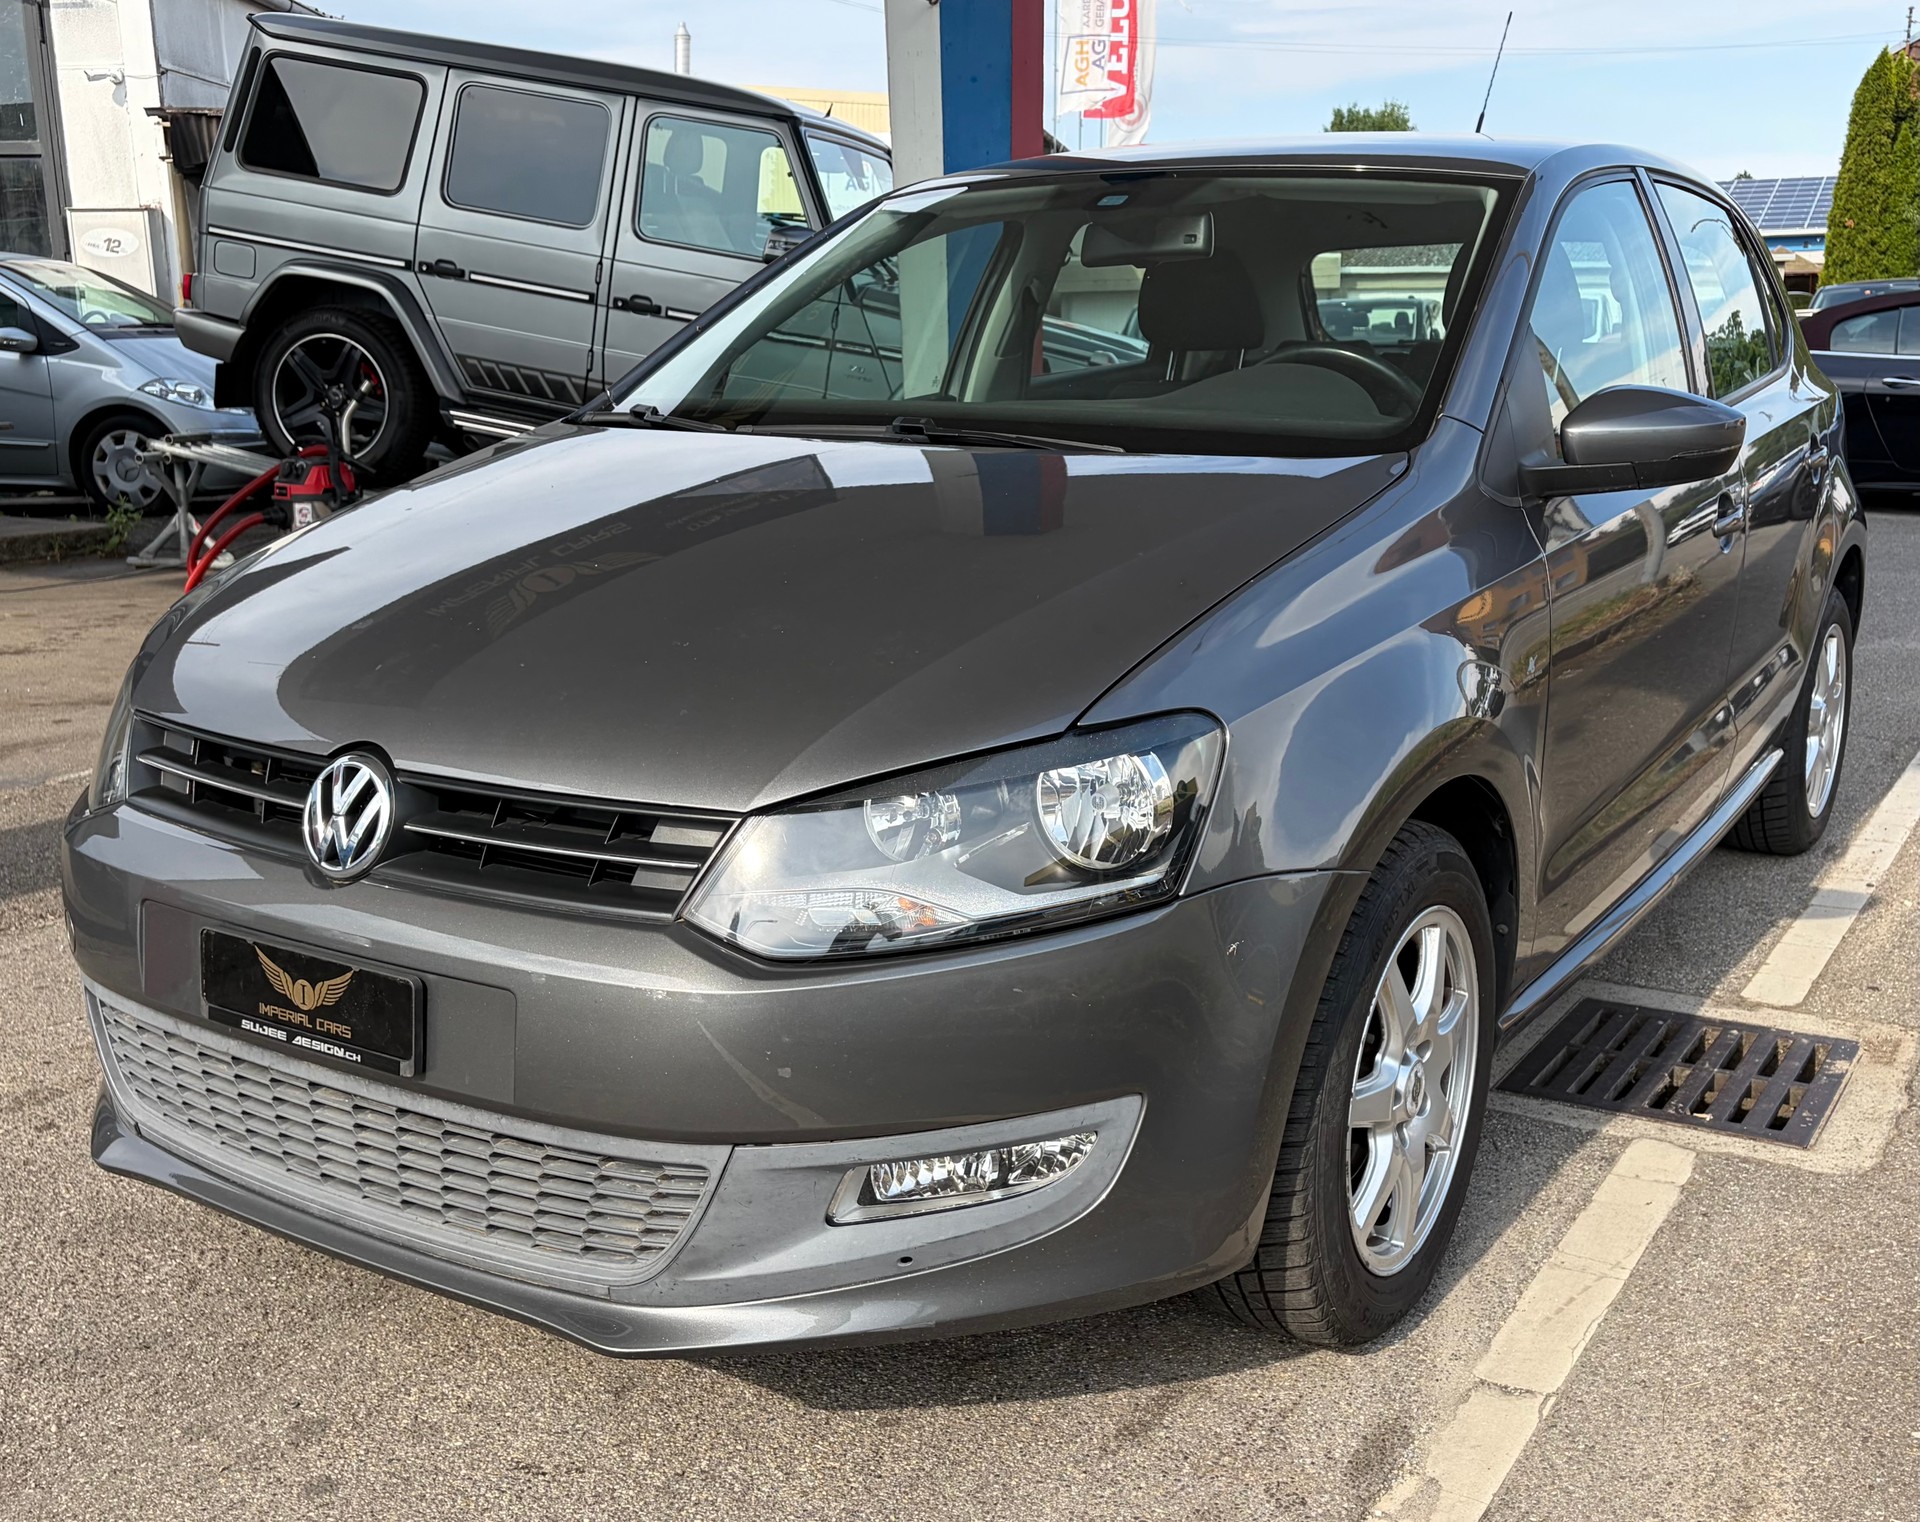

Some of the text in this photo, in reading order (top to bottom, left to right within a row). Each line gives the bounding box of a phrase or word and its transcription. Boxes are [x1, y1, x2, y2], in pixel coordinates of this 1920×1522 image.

[1075, 40, 1090, 87] AGH
[1092, 39, 1106, 71] AG
[103, 237, 122, 254] 12
[241, 1018, 287, 1042] SUJEE
[258, 1002, 351, 1039] IMPERIAL CARS
